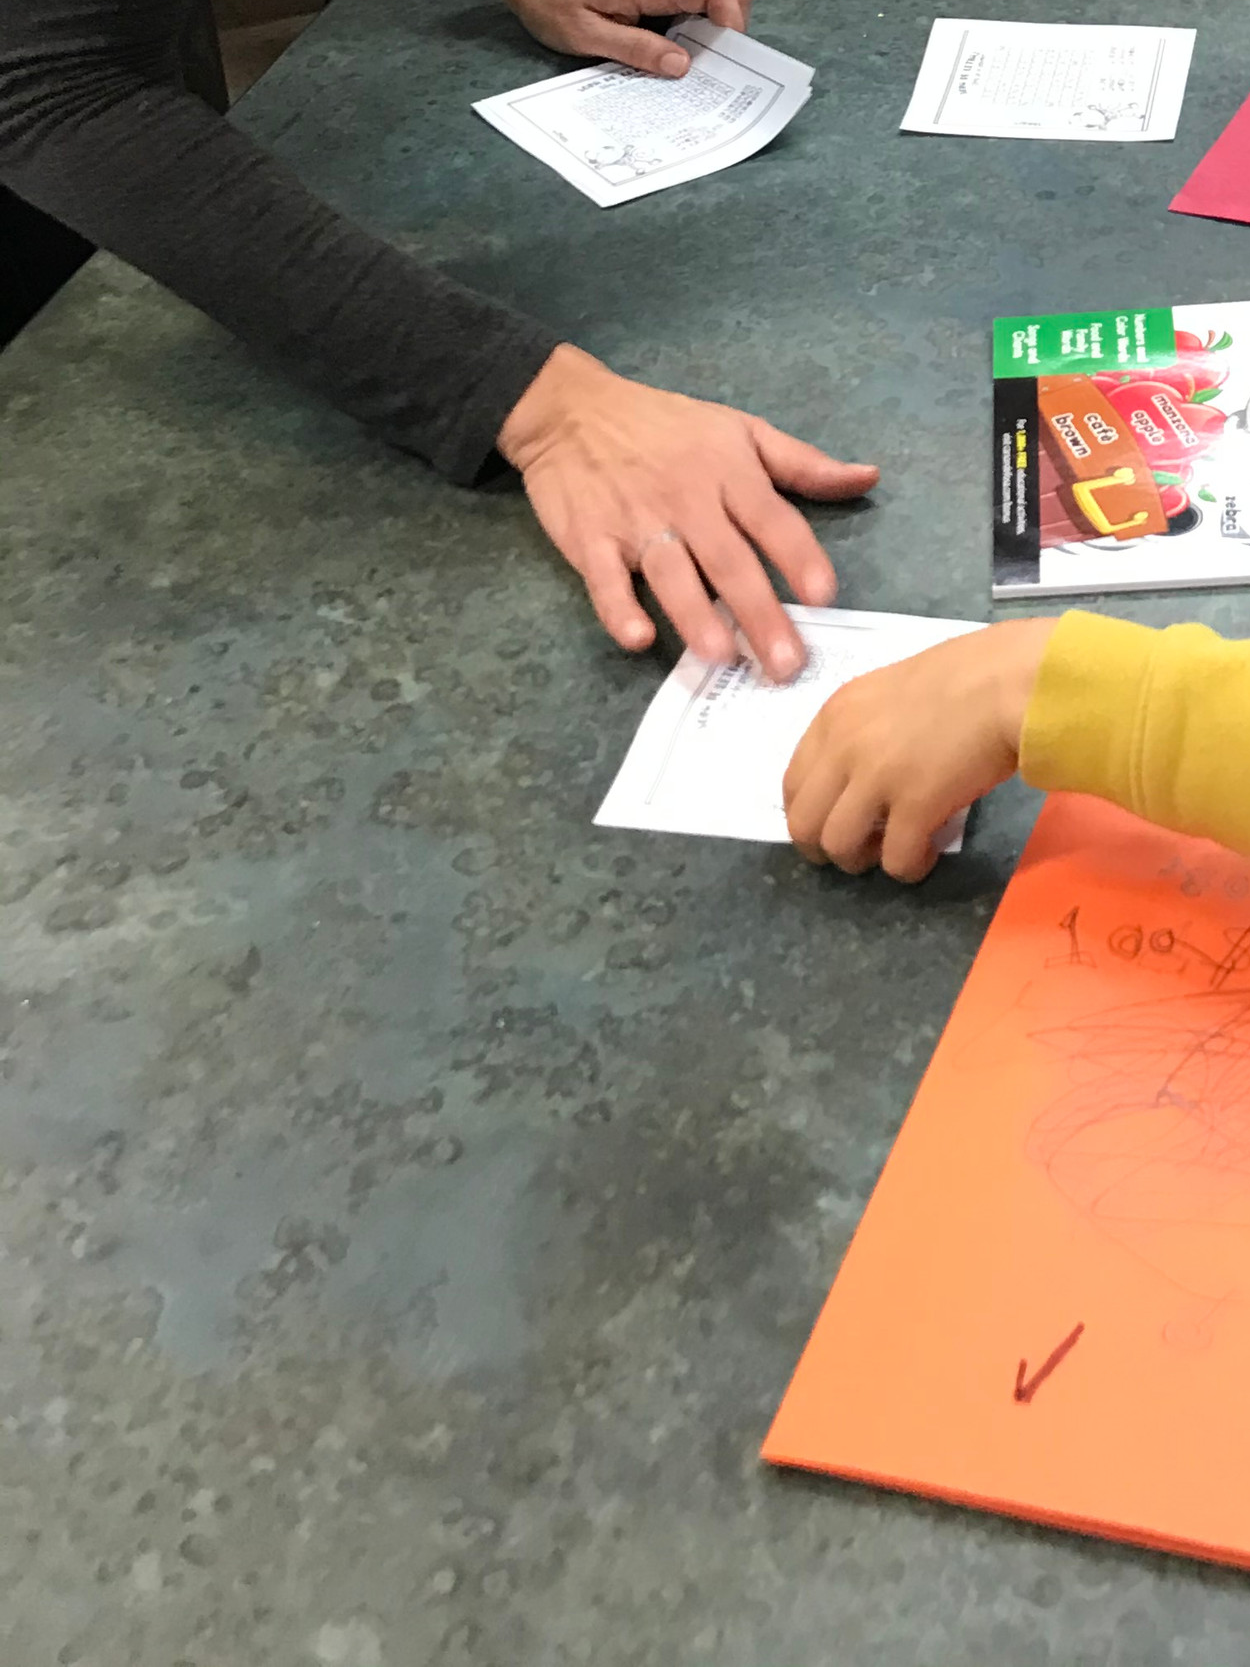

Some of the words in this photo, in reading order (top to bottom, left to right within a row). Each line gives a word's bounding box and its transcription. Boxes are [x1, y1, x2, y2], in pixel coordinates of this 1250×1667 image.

[1054, 415, 1089, 457] brown
[1085, 413, 1118, 443] café
[1132, 410, 1164, 444] apple
[1152, 393, 1197, 445] manzana
[1225, 495, 1242, 532] zebra
